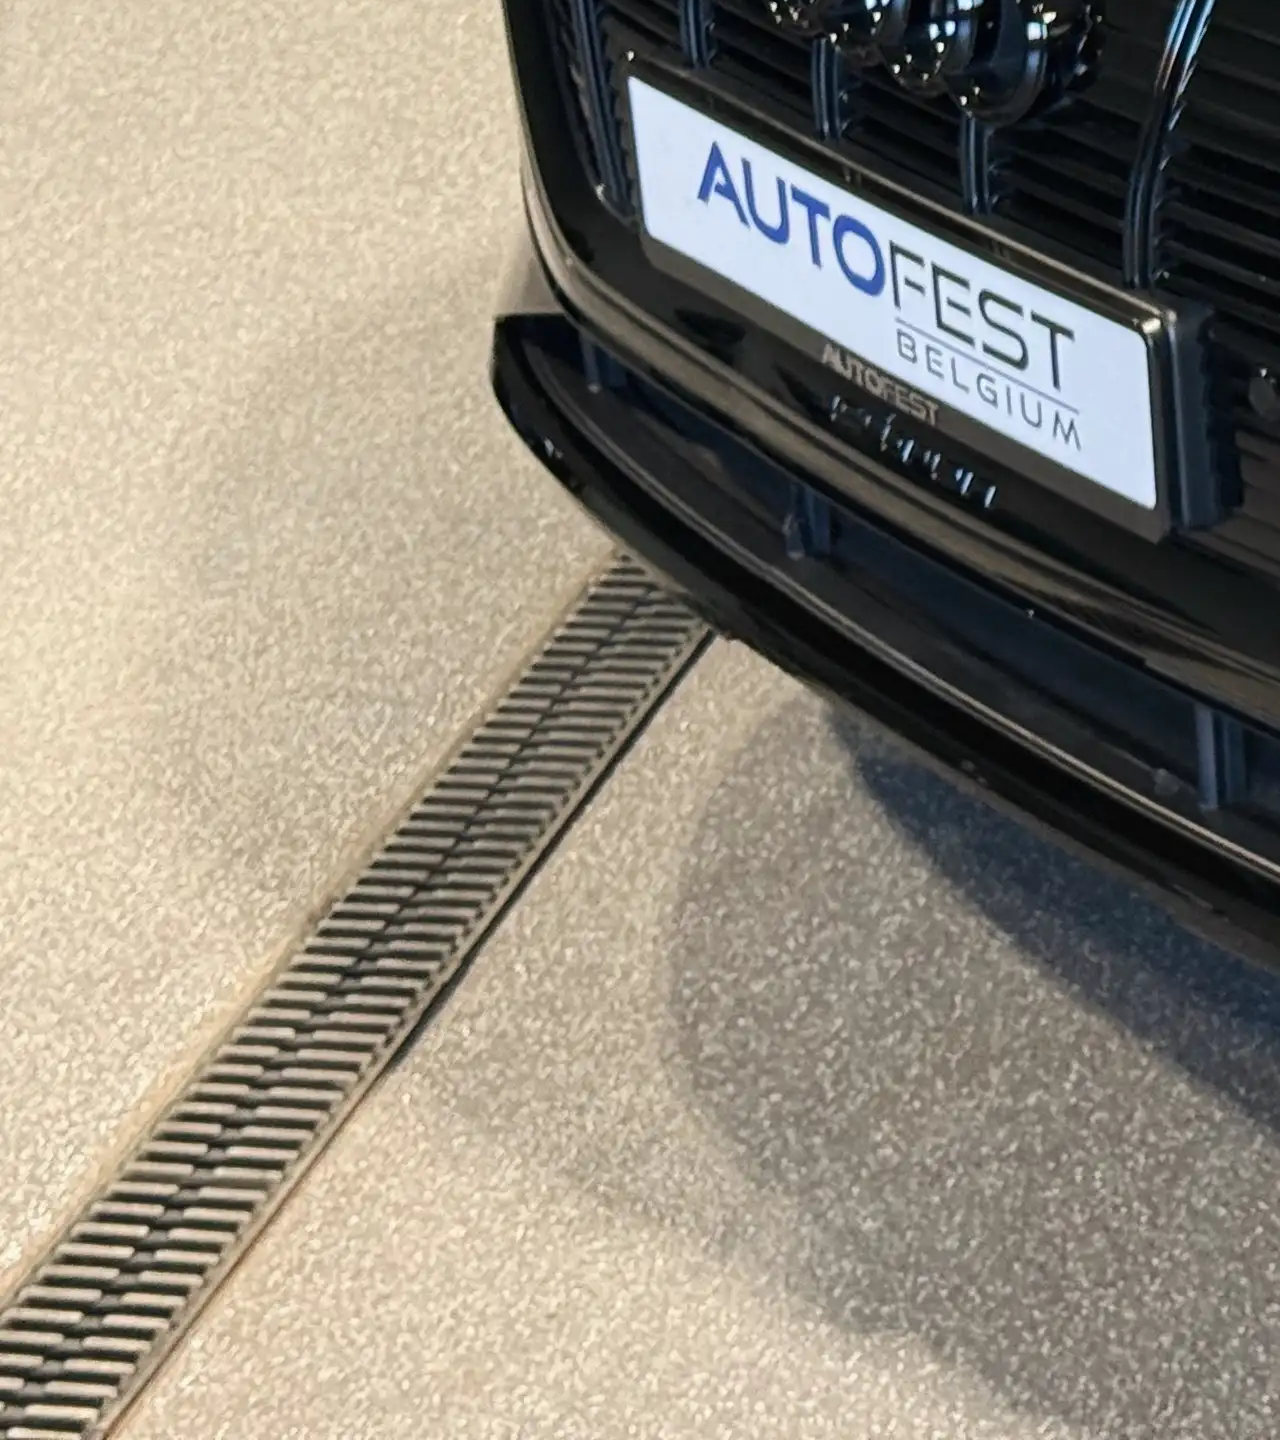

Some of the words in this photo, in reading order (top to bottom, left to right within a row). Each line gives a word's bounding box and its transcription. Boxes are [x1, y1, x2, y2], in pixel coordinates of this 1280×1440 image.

[697, 140, 1075, 391] AUTOFEST
[822, 343, 940, 426] AUTOFEST
[896, 328, 1082, 451] BELGIUM
